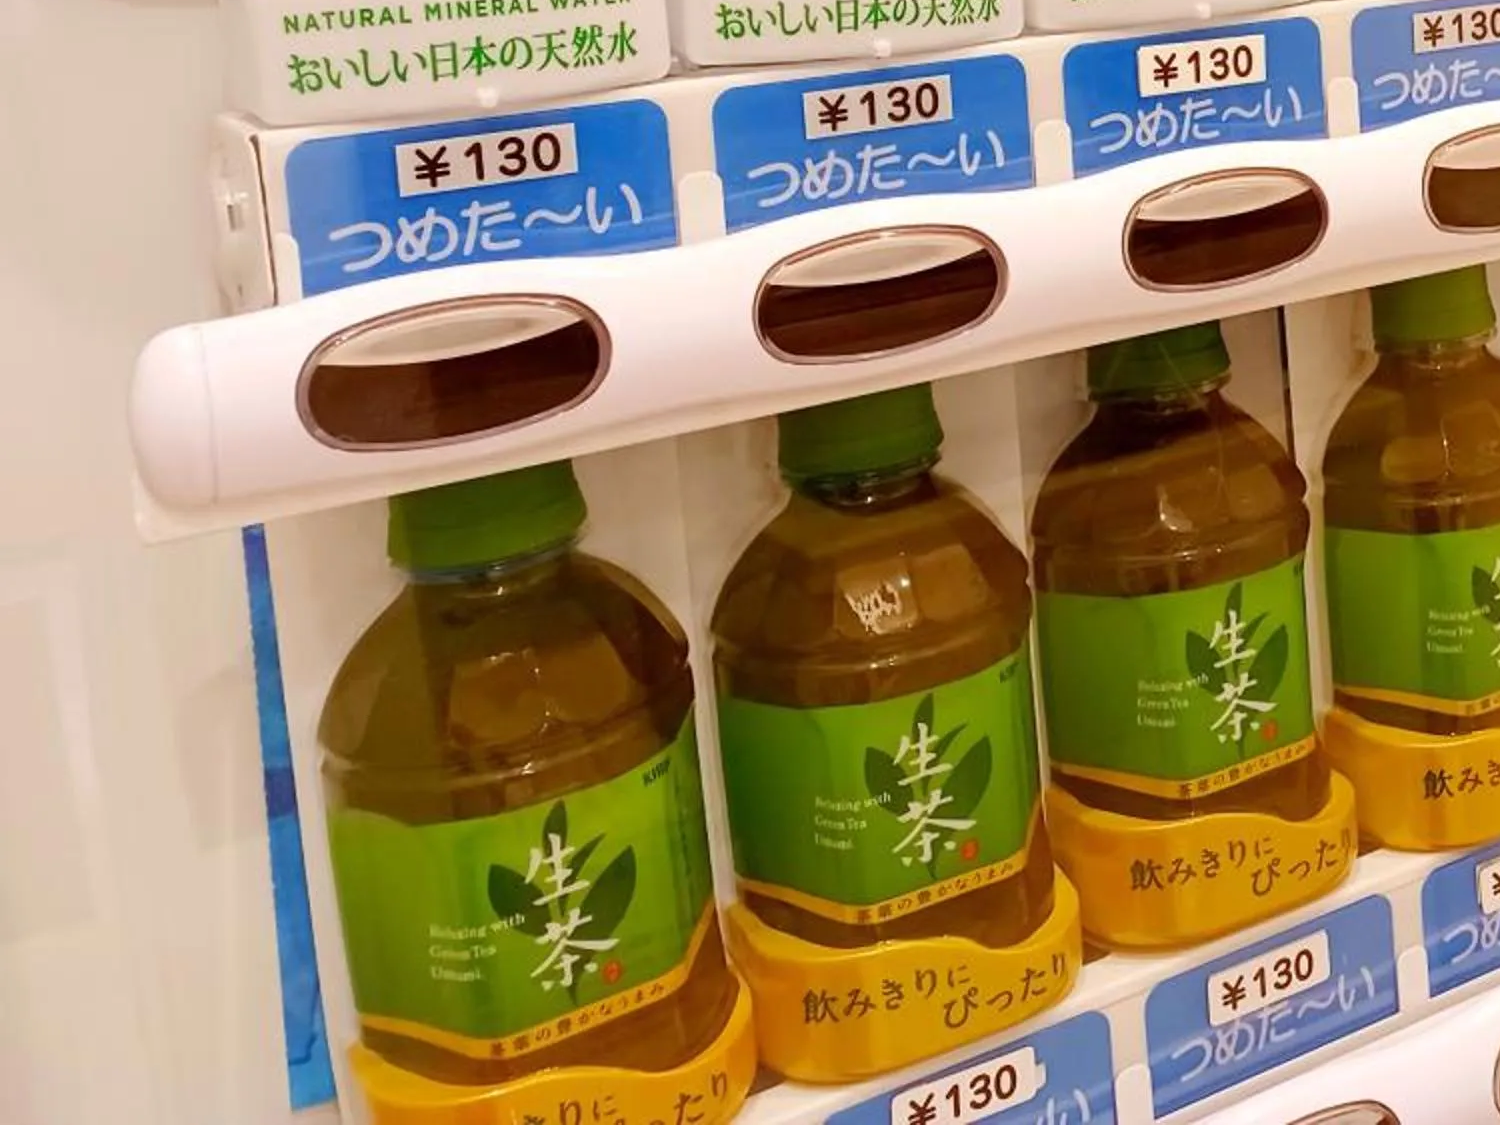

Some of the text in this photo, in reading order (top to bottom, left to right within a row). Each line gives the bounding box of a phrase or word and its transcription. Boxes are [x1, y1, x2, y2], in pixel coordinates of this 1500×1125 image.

[283, 3, 413, 35] NATURAL
[287, 20, 639, 95] おいしい日本の天然水
[1153, 44, 1253, 89] ¥130
[817, 81, 940, 132] ¥130
[414, 131, 563, 189] ¥130
[1209, 609, 1278, 744] 生茶
[892, 722, 977, 867] 生茶
[1129, 836, 1274, 893] 飲みきりに
[524, 831, 621, 993] 生茶
[802, 962, 972, 1025] 飲みきりに
[944, 951, 1067, 1030] ぴったり
[1220, 948, 1314, 1011] ¥130
[907, 1064, 1017, 1125] ¥130
